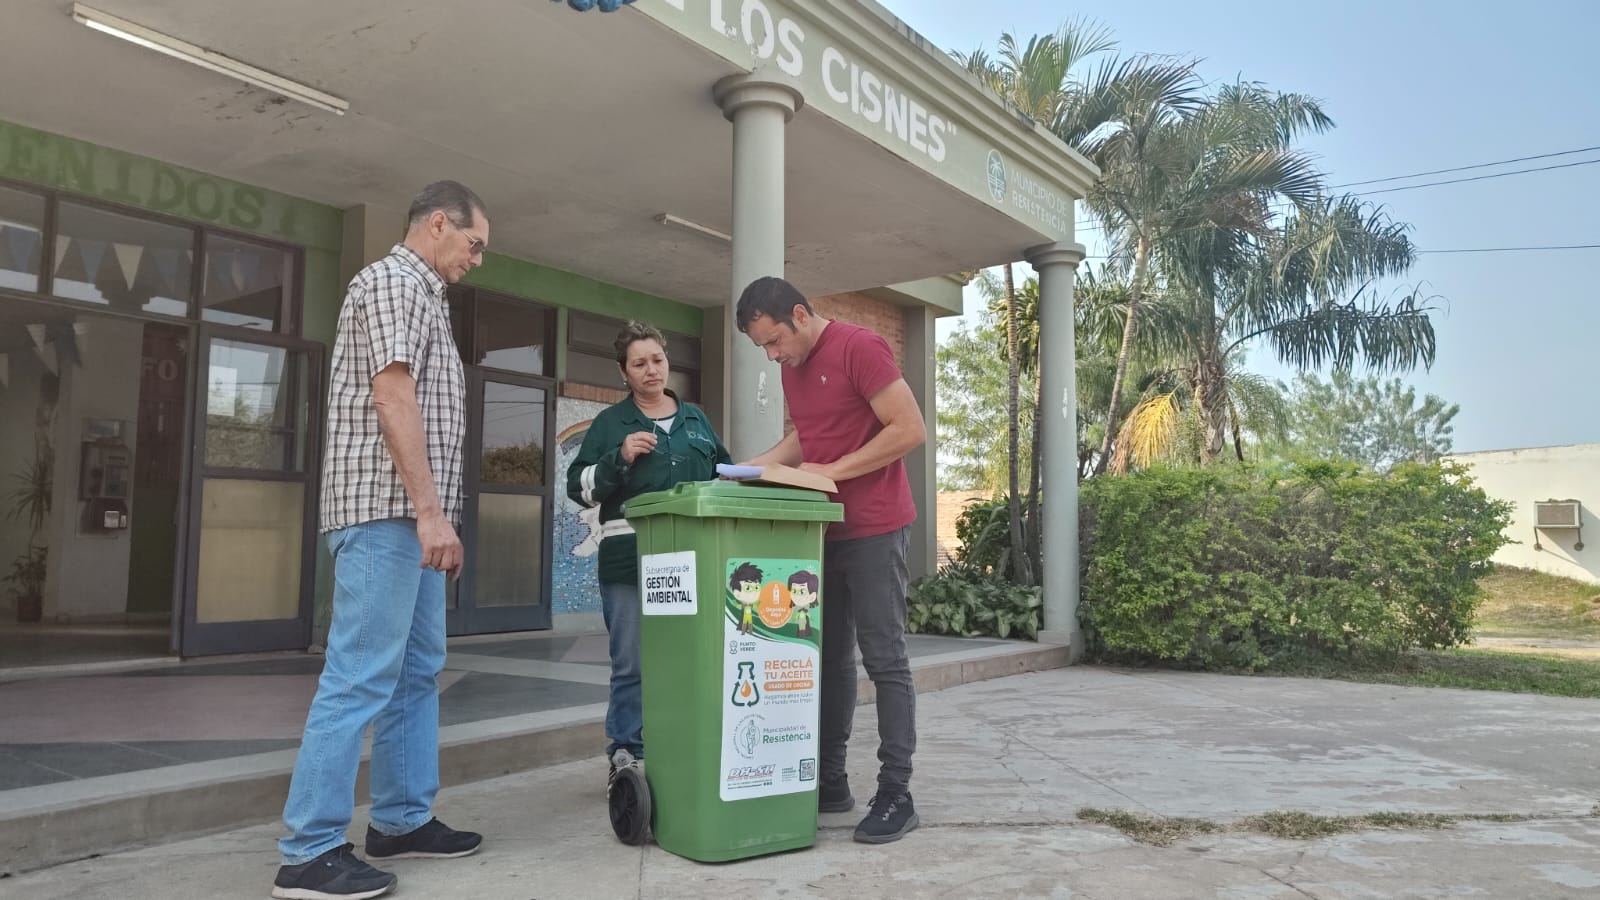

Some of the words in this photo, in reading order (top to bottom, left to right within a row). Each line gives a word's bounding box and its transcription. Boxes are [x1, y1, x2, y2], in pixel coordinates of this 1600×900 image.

[710, 0, 805, 77] LOS
[1011, 190, 1067, 236] RESISTENCIA
[682, 564, 690, 573] de
[646, 590, 693, 604] AMBIENTAL
[764, 671, 777, 680] TU
[780, 670, 813, 679] ACEITE
[763, 733, 811, 744] Resistencia
